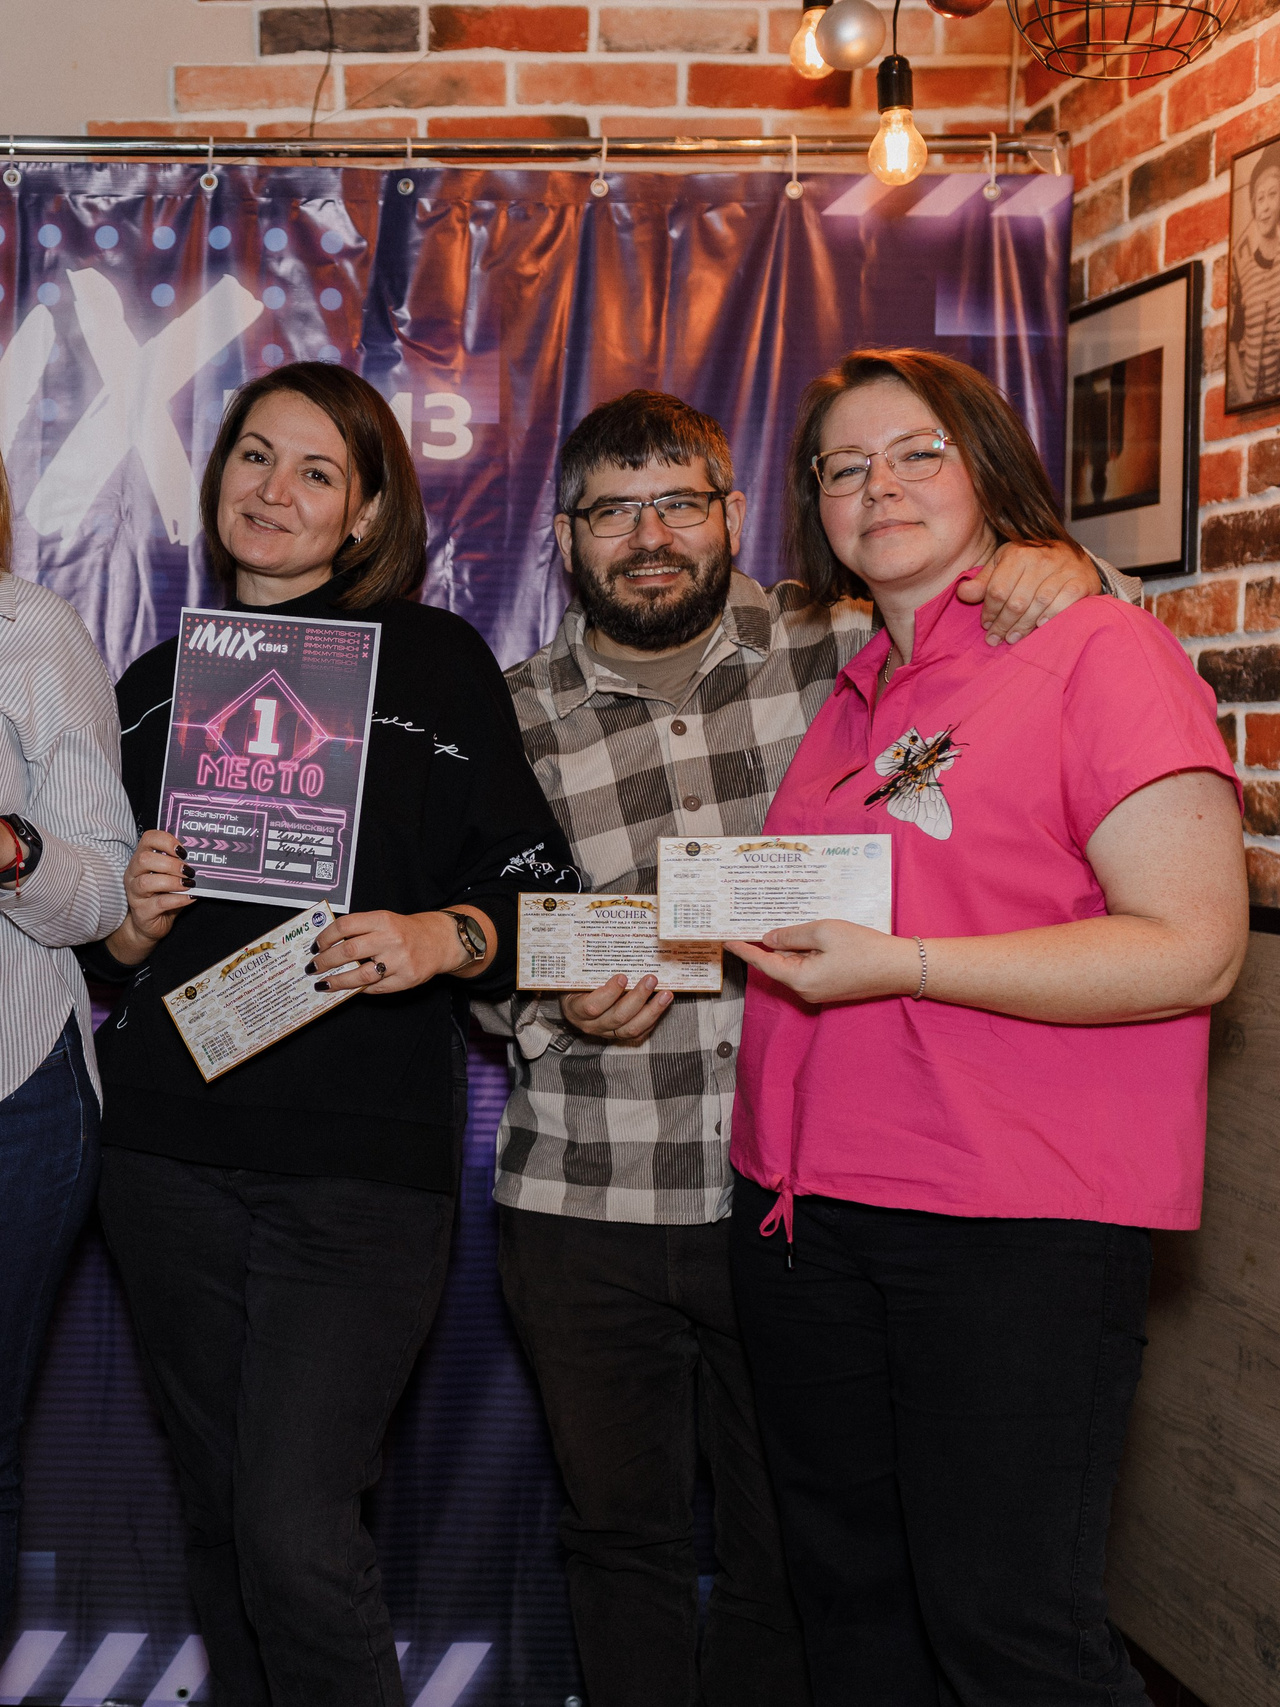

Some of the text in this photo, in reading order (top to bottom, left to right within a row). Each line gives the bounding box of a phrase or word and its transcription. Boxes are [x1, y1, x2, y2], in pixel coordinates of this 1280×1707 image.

[189, 621, 266, 661] IMIX
[258, 642, 289, 654] КВИЗ
[247, 698, 280, 756] 1
[197, 753, 325, 797] МЕСТО
[183, 809, 239, 822] РЕЗУЛЬТАТЫ:
[187, 851, 228, 864] АЛЛЫ:
[743, 852, 802, 862] VOUCHER
[594, 909, 647, 918] VOUCHER
[228, 952, 272, 982] VOUCHER
